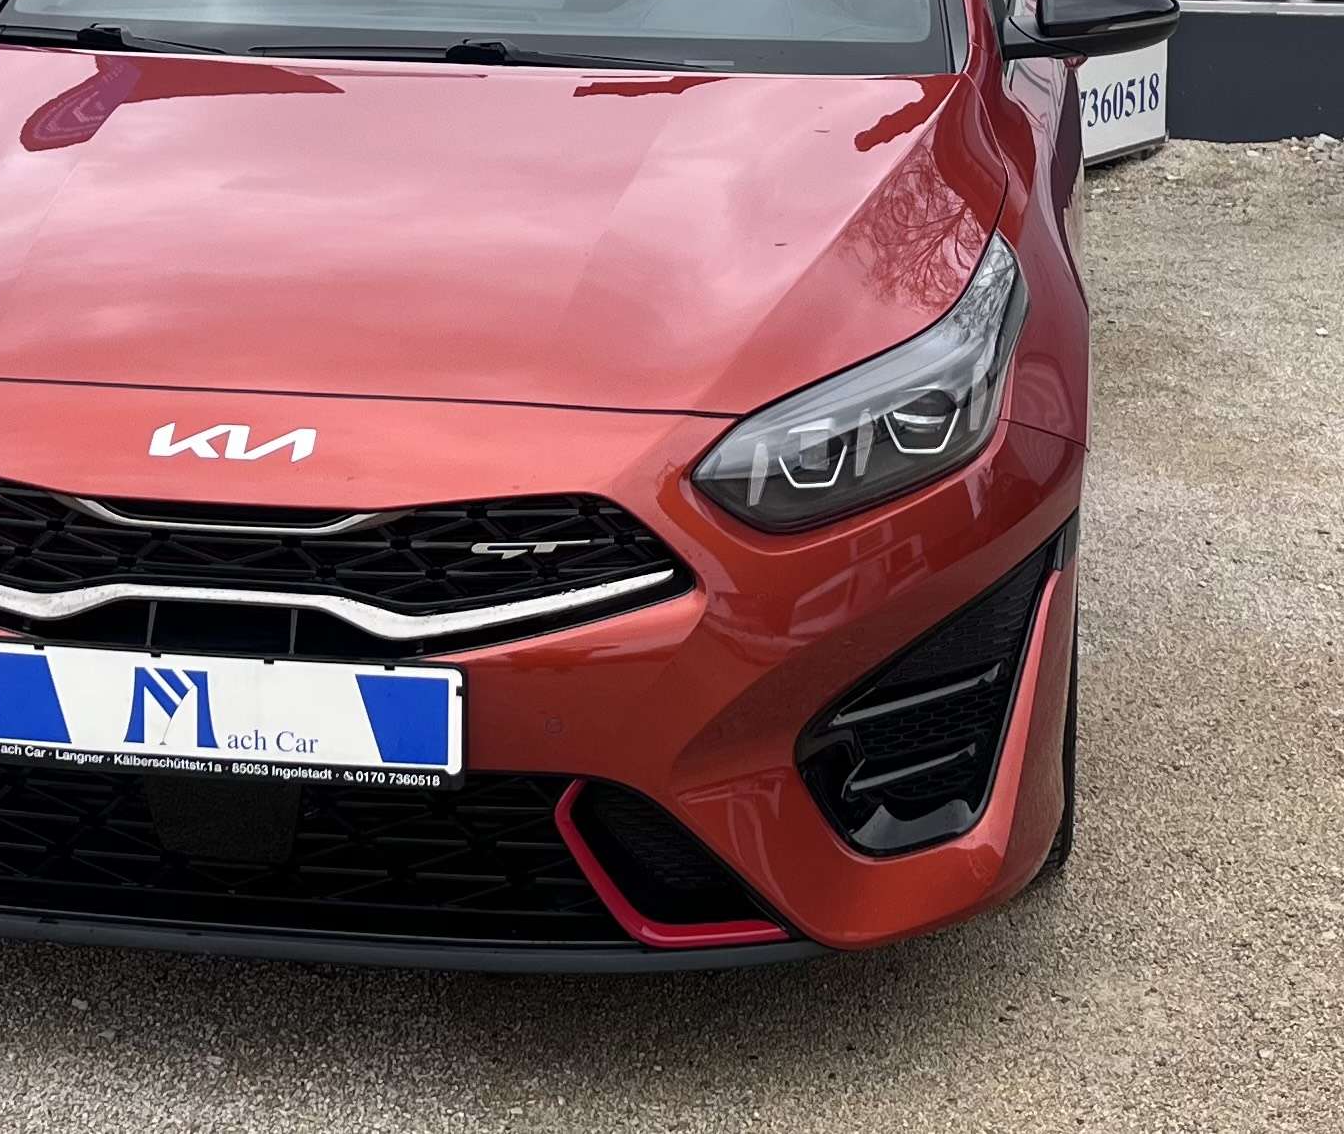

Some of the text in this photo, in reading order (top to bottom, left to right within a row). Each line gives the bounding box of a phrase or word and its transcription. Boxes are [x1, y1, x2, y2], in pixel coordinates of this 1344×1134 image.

[149, 422, 316, 462] KIA
[276, 730, 319, 754] Car
[24, 746, 46, 758] Car
[55, 749, 104, 765] Langner
[231, 762, 269, 776] 85053
[271, 766, 333, 781] Ingolstadt
[355, 771, 386, 783] 0170
[388, 772, 440, 786] 7360518
